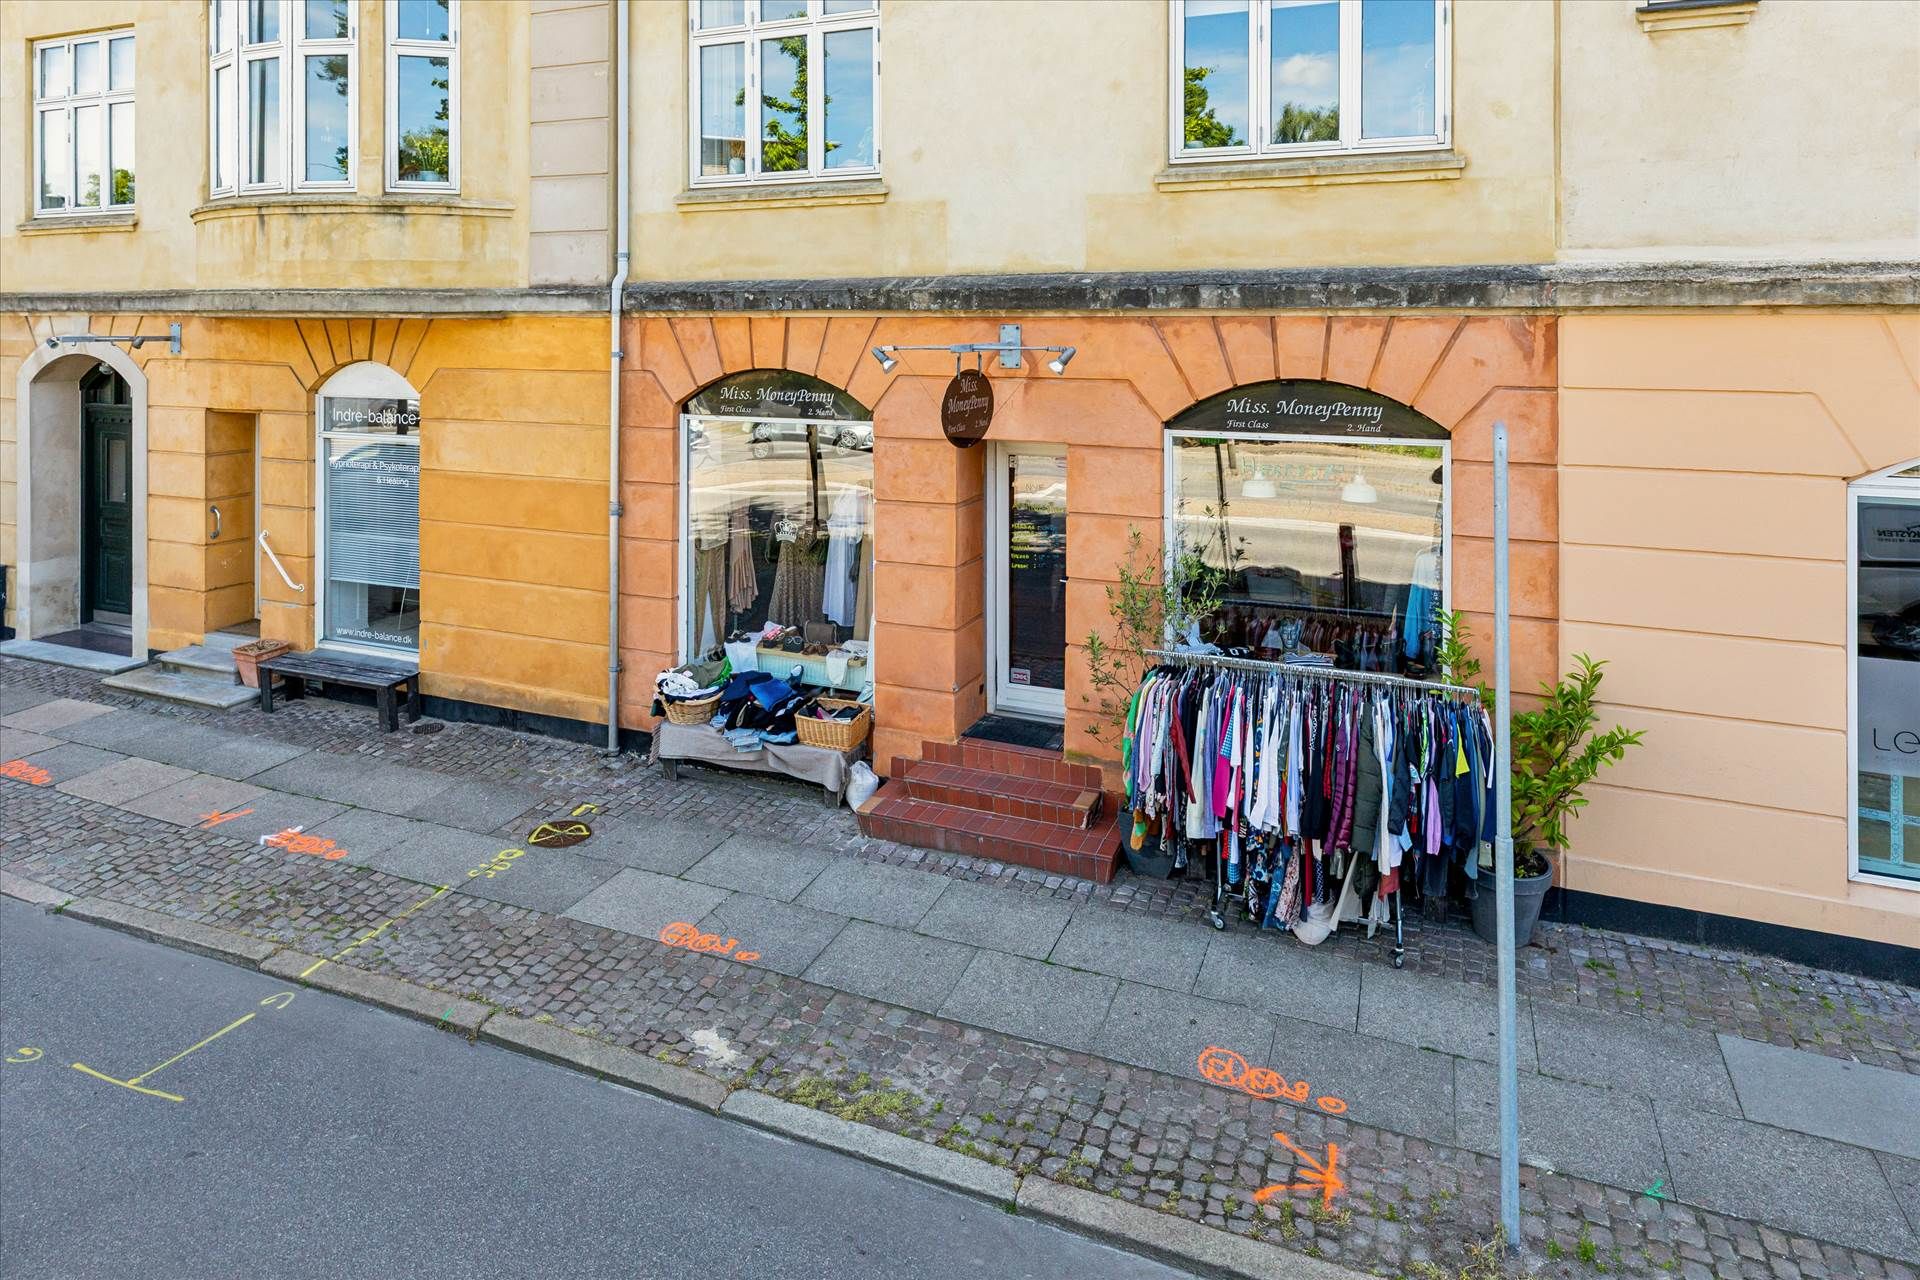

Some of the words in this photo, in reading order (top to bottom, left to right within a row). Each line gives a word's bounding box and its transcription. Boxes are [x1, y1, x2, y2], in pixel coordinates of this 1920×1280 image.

[720, 387, 752, 400] Miss.
[757, 386, 835, 408] MoneyPenny
[720, 405, 735, 414] First
[735, 405, 752, 414] Class
[808, 408, 814, 416] 2.
[815, 408, 833, 416] Hand
[1227, 398, 1270, 414] Miss.
[1276, 399, 1383, 423] MoneyPenny
[1227, 420, 1246, 429] First
[1247, 420, 1270, 429] Class
[1346, 424, 1355, 433] 2.
[1356, 424, 1382, 433] Hand
[335, 627, 413, 644] www.indre-balance.dk
